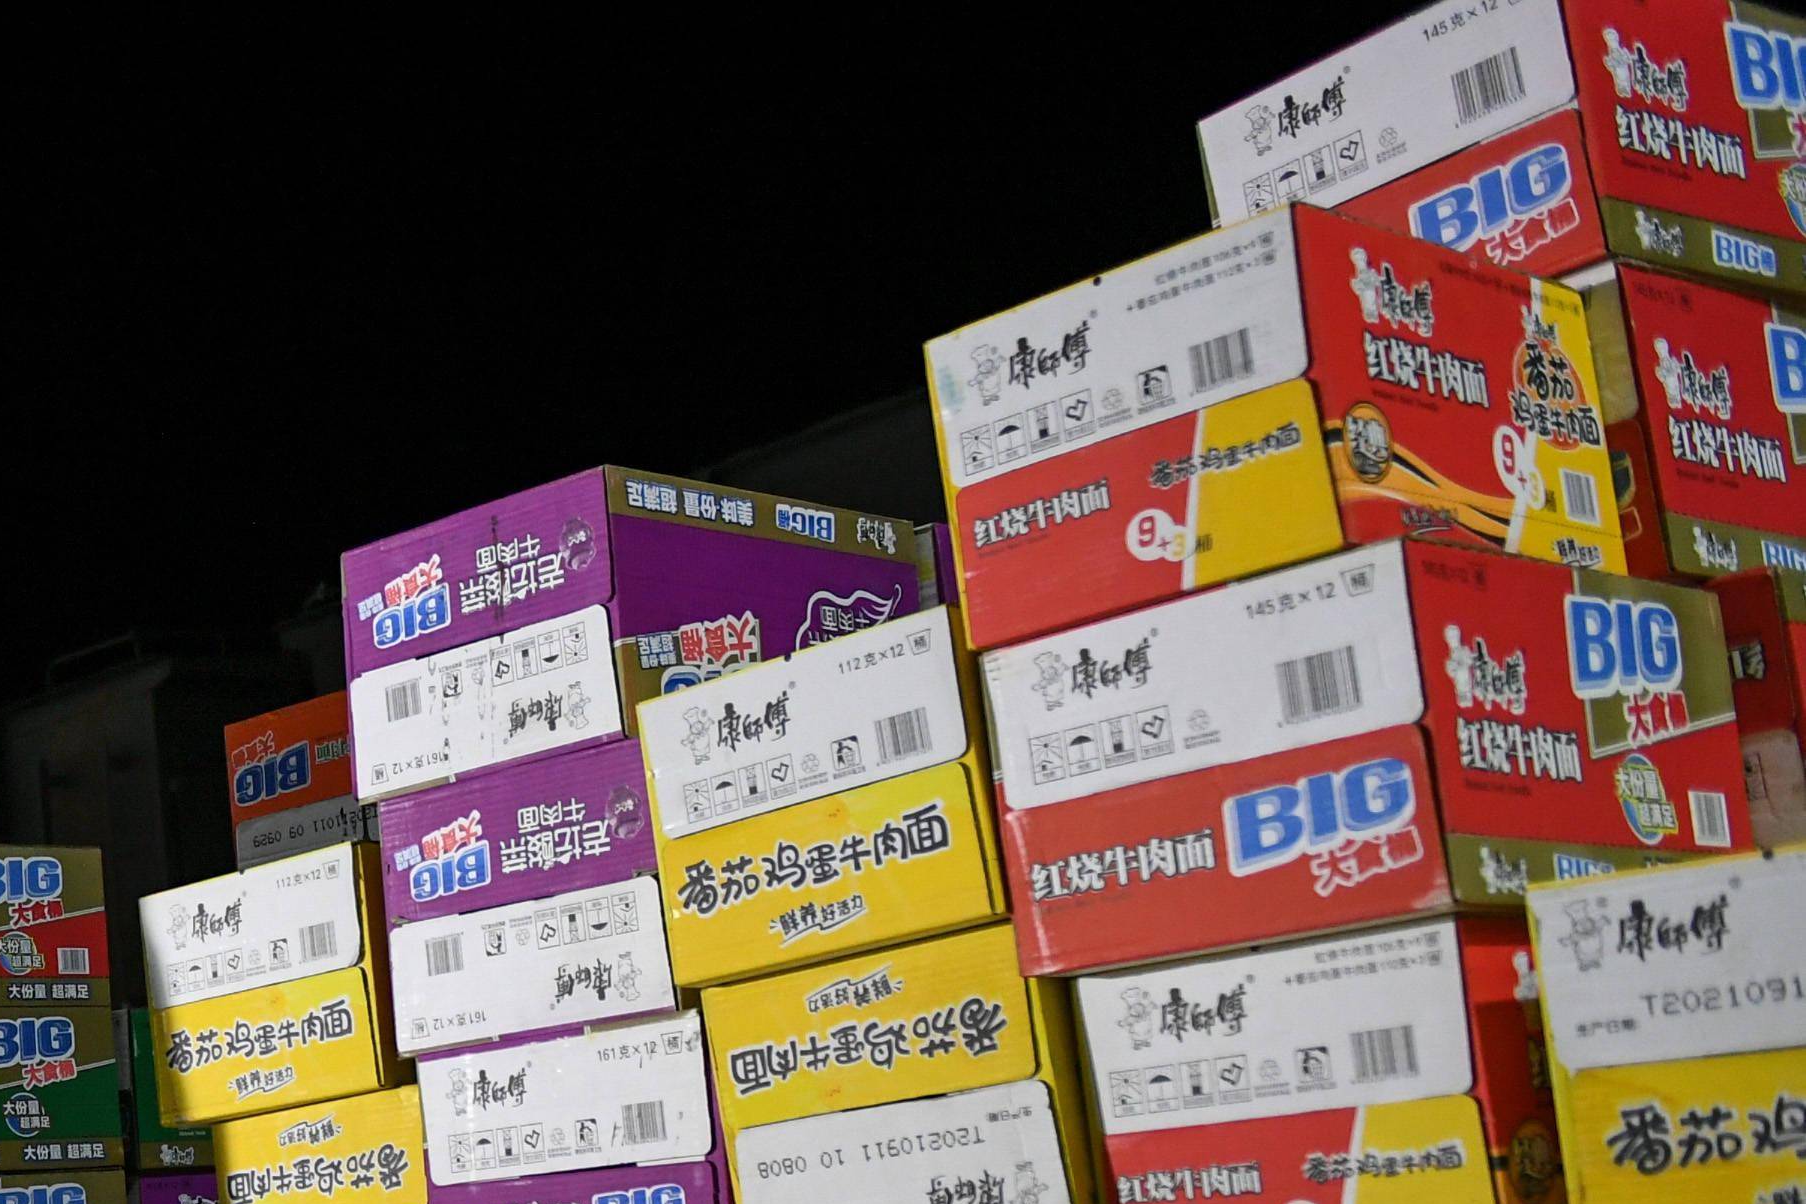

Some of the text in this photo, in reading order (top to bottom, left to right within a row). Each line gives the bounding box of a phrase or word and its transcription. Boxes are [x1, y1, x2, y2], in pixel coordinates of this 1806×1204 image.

[1616, 104, 1746, 179] 红烧牛肉面
[1410, 142, 1572, 253] BIG
[1363, 331, 1490, 408] 红烧牛肉面
[1525, 343, 1576, 399] 番茄
[1669, 415, 1786, 483] 红烧牛肉面
[973, 478, 1111, 550] 红烧牛肉面
[458, 552, 565, 615] 老坛酸菜
[476, 533, 542, 570] 牛肉面
[373, 582, 451, 649] BIG
[1564, 593, 1684, 700] BIG
[233, 741, 311, 807] BIG
[1456, 718, 1584, 782] 红烧牛肉面
[500, 816, 611, 874] 老坛酸菜
[517, 797, 588, 831] 牛肉面
[1222, 756, 1415, 876] BIG
[412, 838, 491, 902] BIG
[677, 802, 950, 917] 番茄鸡蛋牛肉面
[1030, 829, 1216, 902] 红烧牛肉面
[9, 899, 64, 929] 大食桶
[7, 983, 90, 1000] 大份量 超满足
[10, 953, 45, 969] 超满足
[166, 1000, 353, 1073] 番茄鸡蛋牛肉面
[729, 997, 1008, 1096] 番茄鸡蛋牛肉面
[22, 1059, 76, 1091] 大食桶
[3, 1100, 43, 1118] 大份量
[19, 1114, 52, 1130] 超满足
[23, 1143, 106, 1161] 大份量 超满足
[756, 1125, 986, 1179] T20210911 10 0808
[1116, 1160, 1263, 1204] 红烧牛肉面
